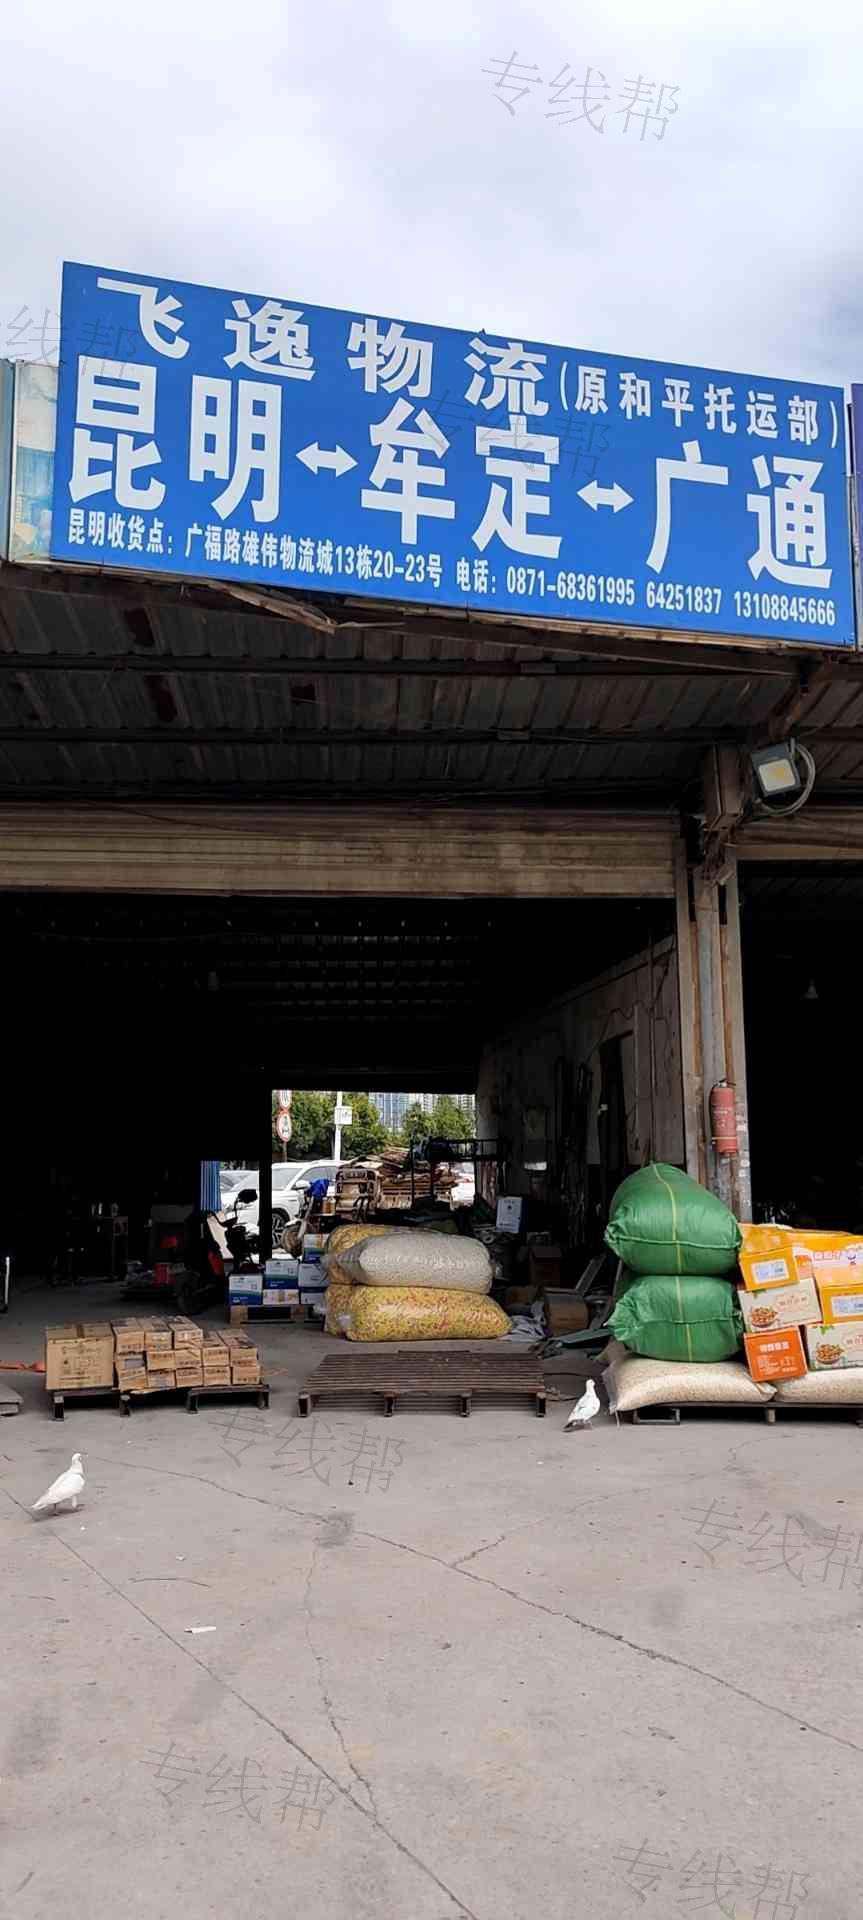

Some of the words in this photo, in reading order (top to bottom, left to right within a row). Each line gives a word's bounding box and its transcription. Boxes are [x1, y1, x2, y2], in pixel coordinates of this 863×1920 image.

[97, 276, 549, 417] 飞逸物流
[68, 355, 282, 523] 昆明
[361, 397, 562, 559] 牟定
[646, 439, 833, 589] 广通
[646, 581, 722, 614] 64251837
[734, 591, 836, 626] 13108845666
